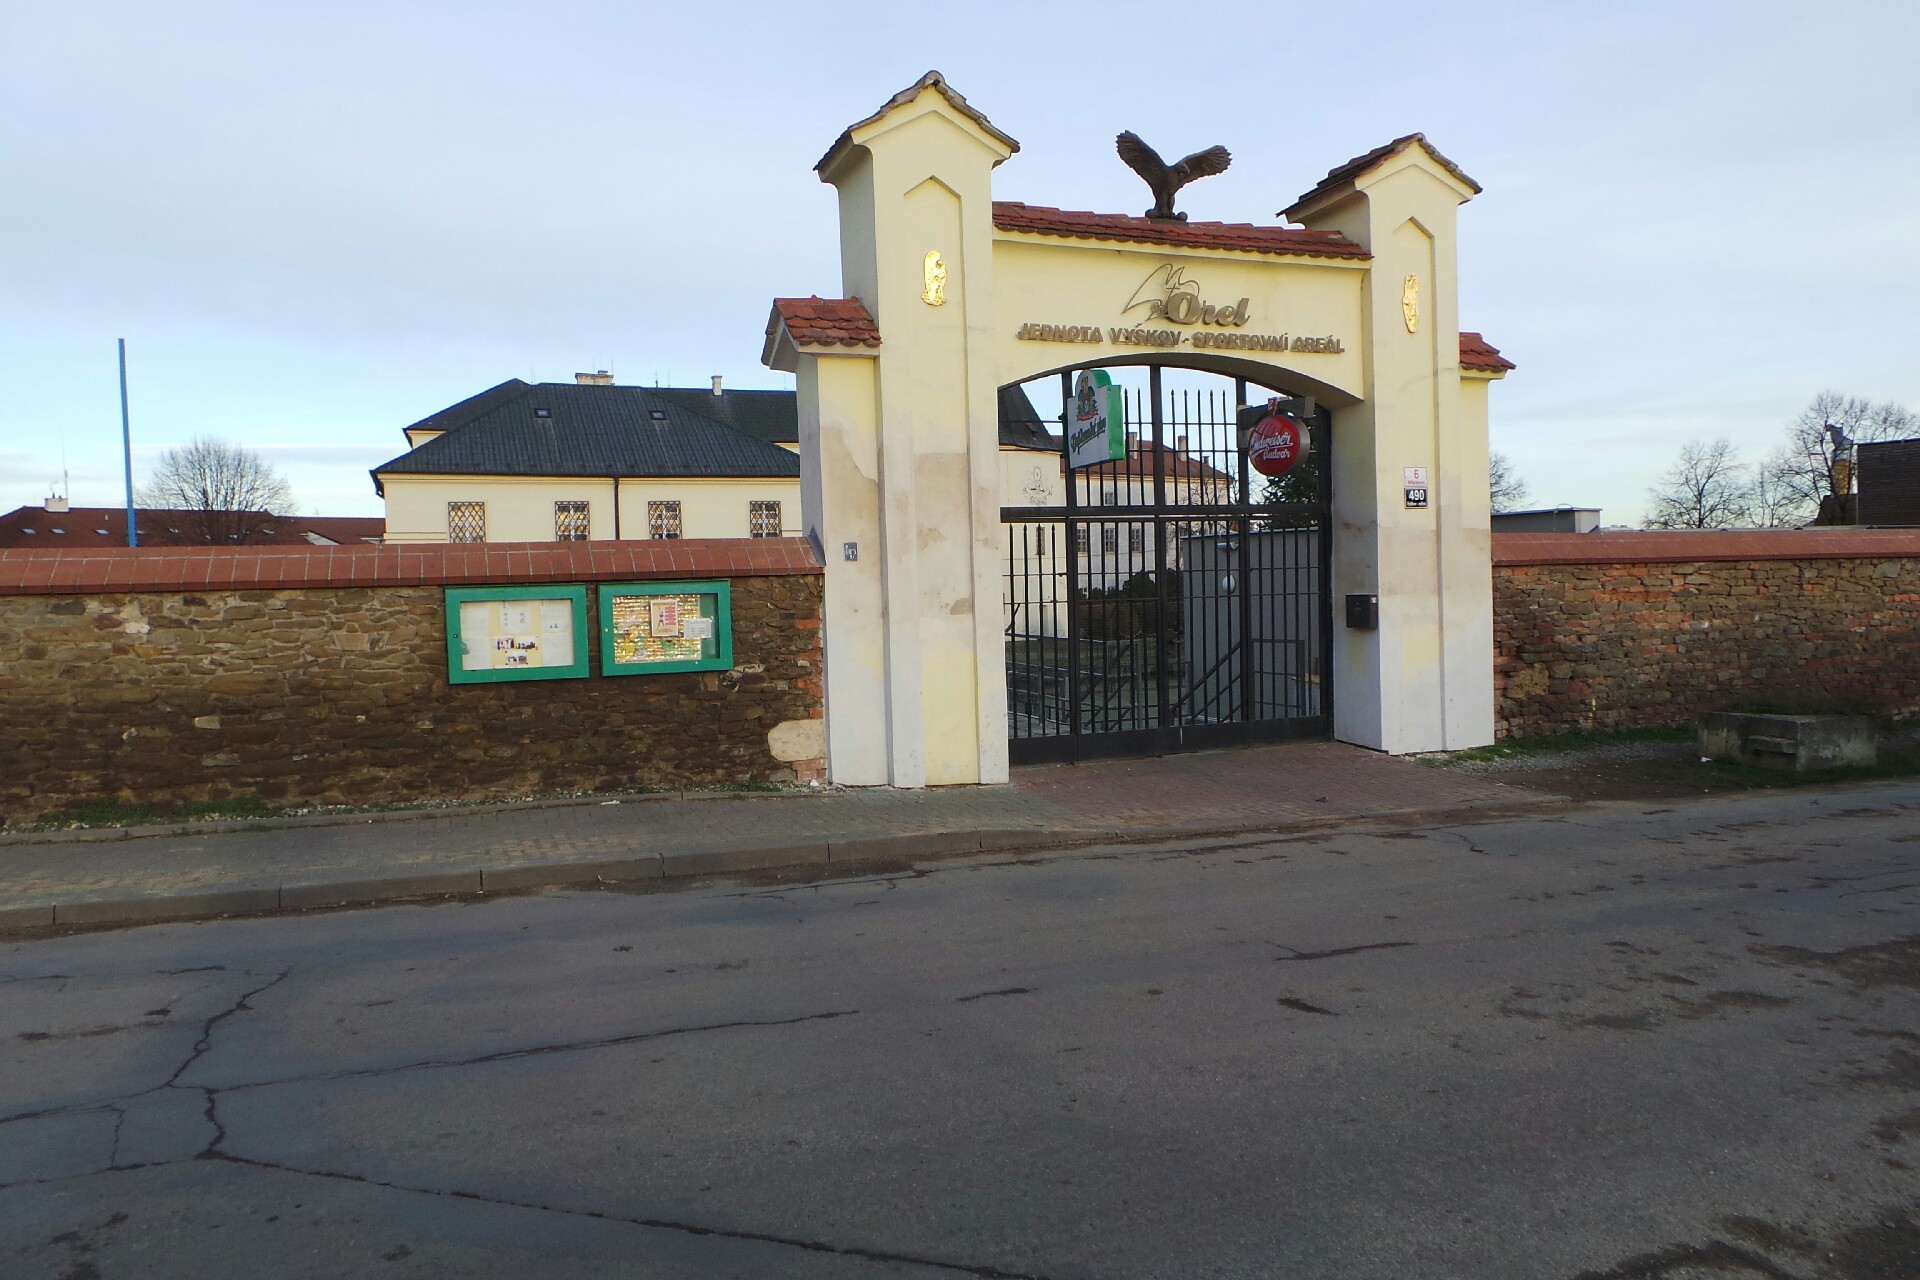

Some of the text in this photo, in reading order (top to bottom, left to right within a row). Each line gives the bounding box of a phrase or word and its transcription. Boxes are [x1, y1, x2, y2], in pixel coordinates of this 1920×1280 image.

[1166, 291, 1250, 327] Orel
[1016, 322, 1104, 344] JEDNOTA
[1109, 322, 1182, 347] VYŠKOV
[1191, 332, 1289, 352] SPORTOVNÍ
[1290, 335, 1346, 354] AREÁL
[1413, 469, 1420, 479] 6
[1408, 489, 1425, 501] 490
